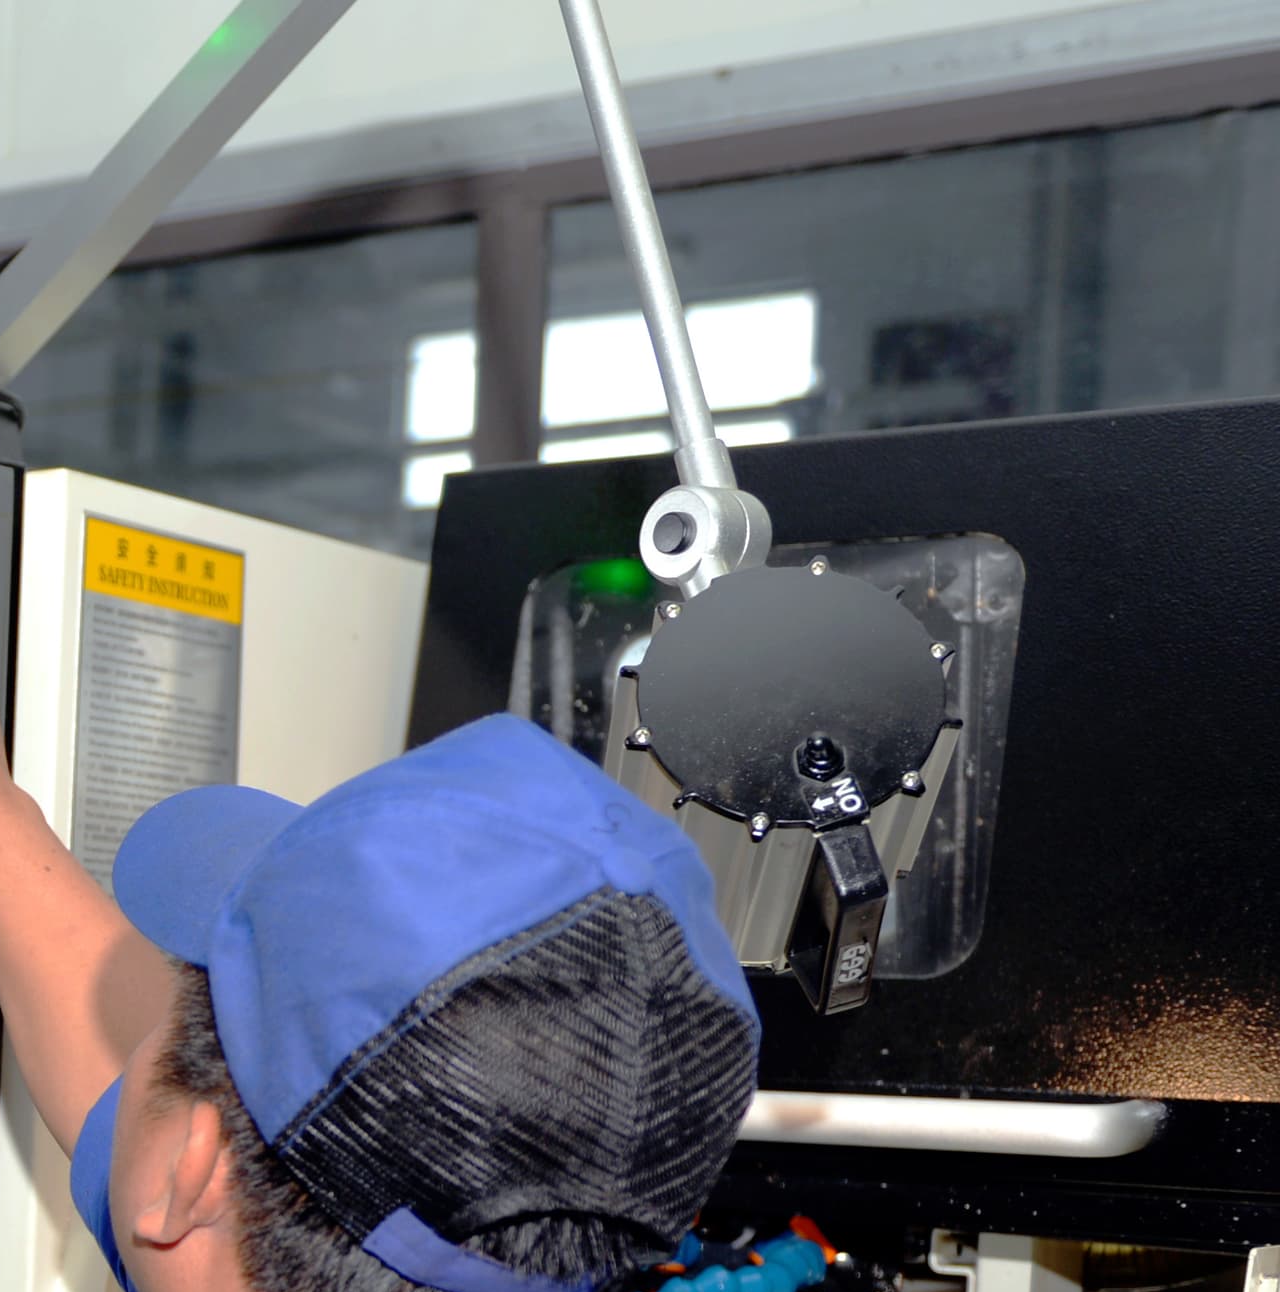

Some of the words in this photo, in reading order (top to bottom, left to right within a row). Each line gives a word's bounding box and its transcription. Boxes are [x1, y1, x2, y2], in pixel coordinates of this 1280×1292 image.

[99, 563, 145, 591] SAFETY
[148, 574, 230, 609] INSTRUCTION
[832, 777, 862, 812] ON
